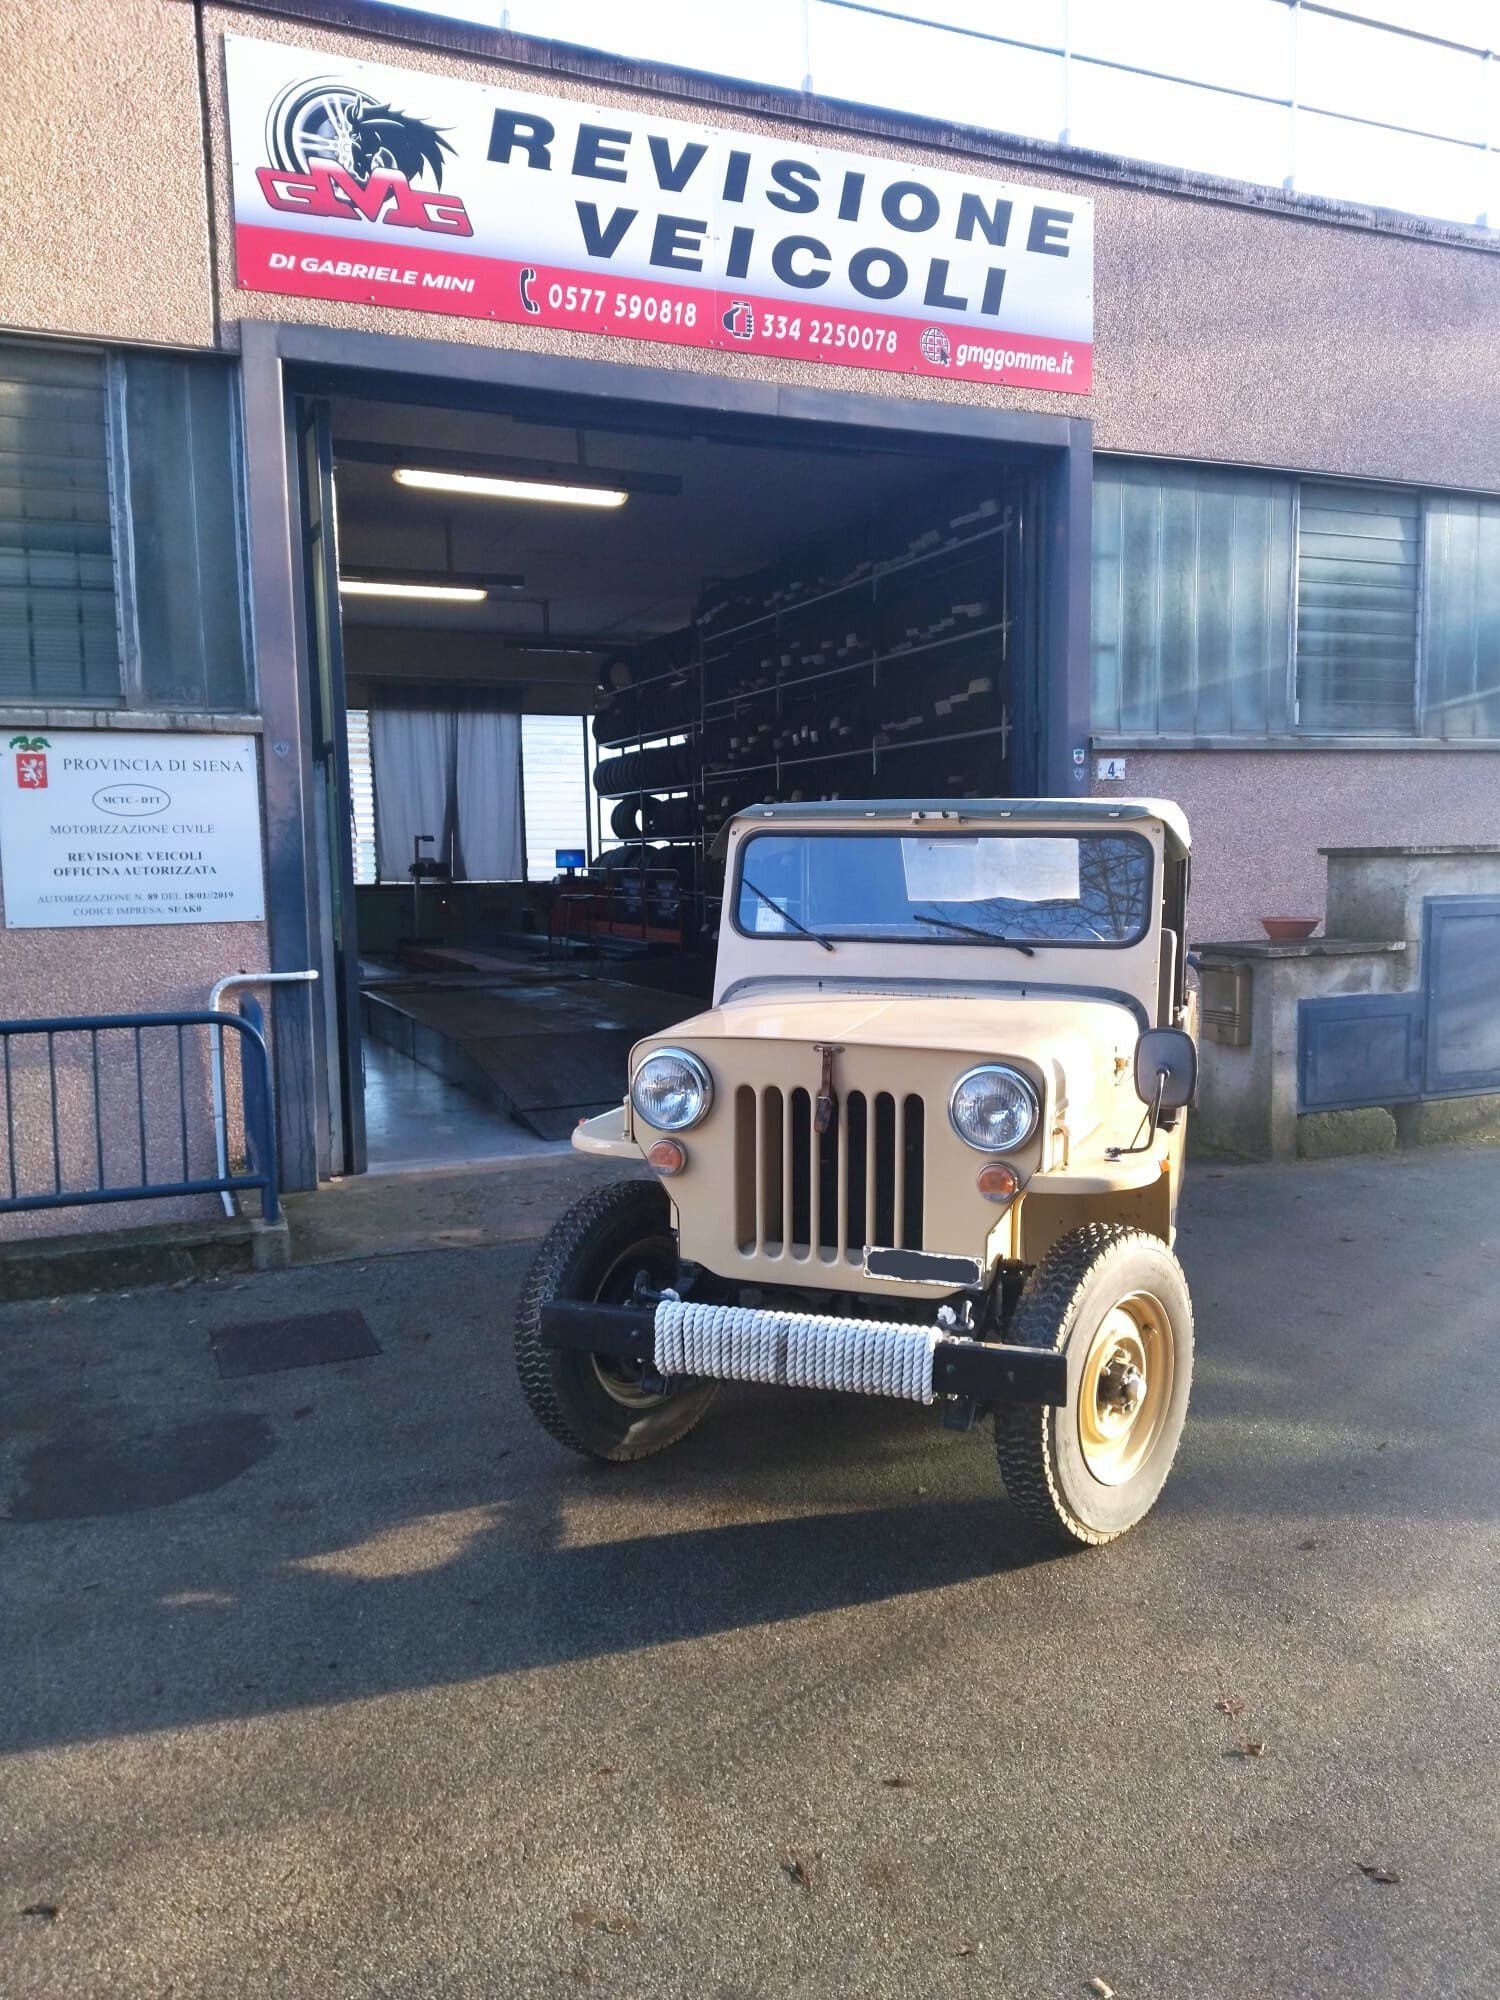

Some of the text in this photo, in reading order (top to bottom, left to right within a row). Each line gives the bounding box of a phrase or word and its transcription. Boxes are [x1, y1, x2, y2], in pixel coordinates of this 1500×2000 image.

[487, 107, 1074, 257] REVISIONE
[574, 200, 1007, 315] VEICOLI
[269, 253, 475, 293] DI GABRIELE MINI
[548, 284, 697, 327] 0577 590818
[761, 314, 897, 353] 334 2250078
[956, 345, 1074, 375] gmggomme.it
[63, 758, 244, 773] PROVINCIA DI SIENA
[1107, 761, 1115, 777] 4
[102, 796, 133, 805] MCTC
[141, 796, 162, 805] DTT
[50, 824, 215, 835] MOTORIZZAZIONE CIVILE
[68, 851, 202, 862] REVISIONE VEICOLI
[53, 866, 217, 877] OFFICINA AUTORIZZATA
[38, 893, 131, 904] AUTORIZZAZIONE
[73, 907, 113, 916] CODICE
